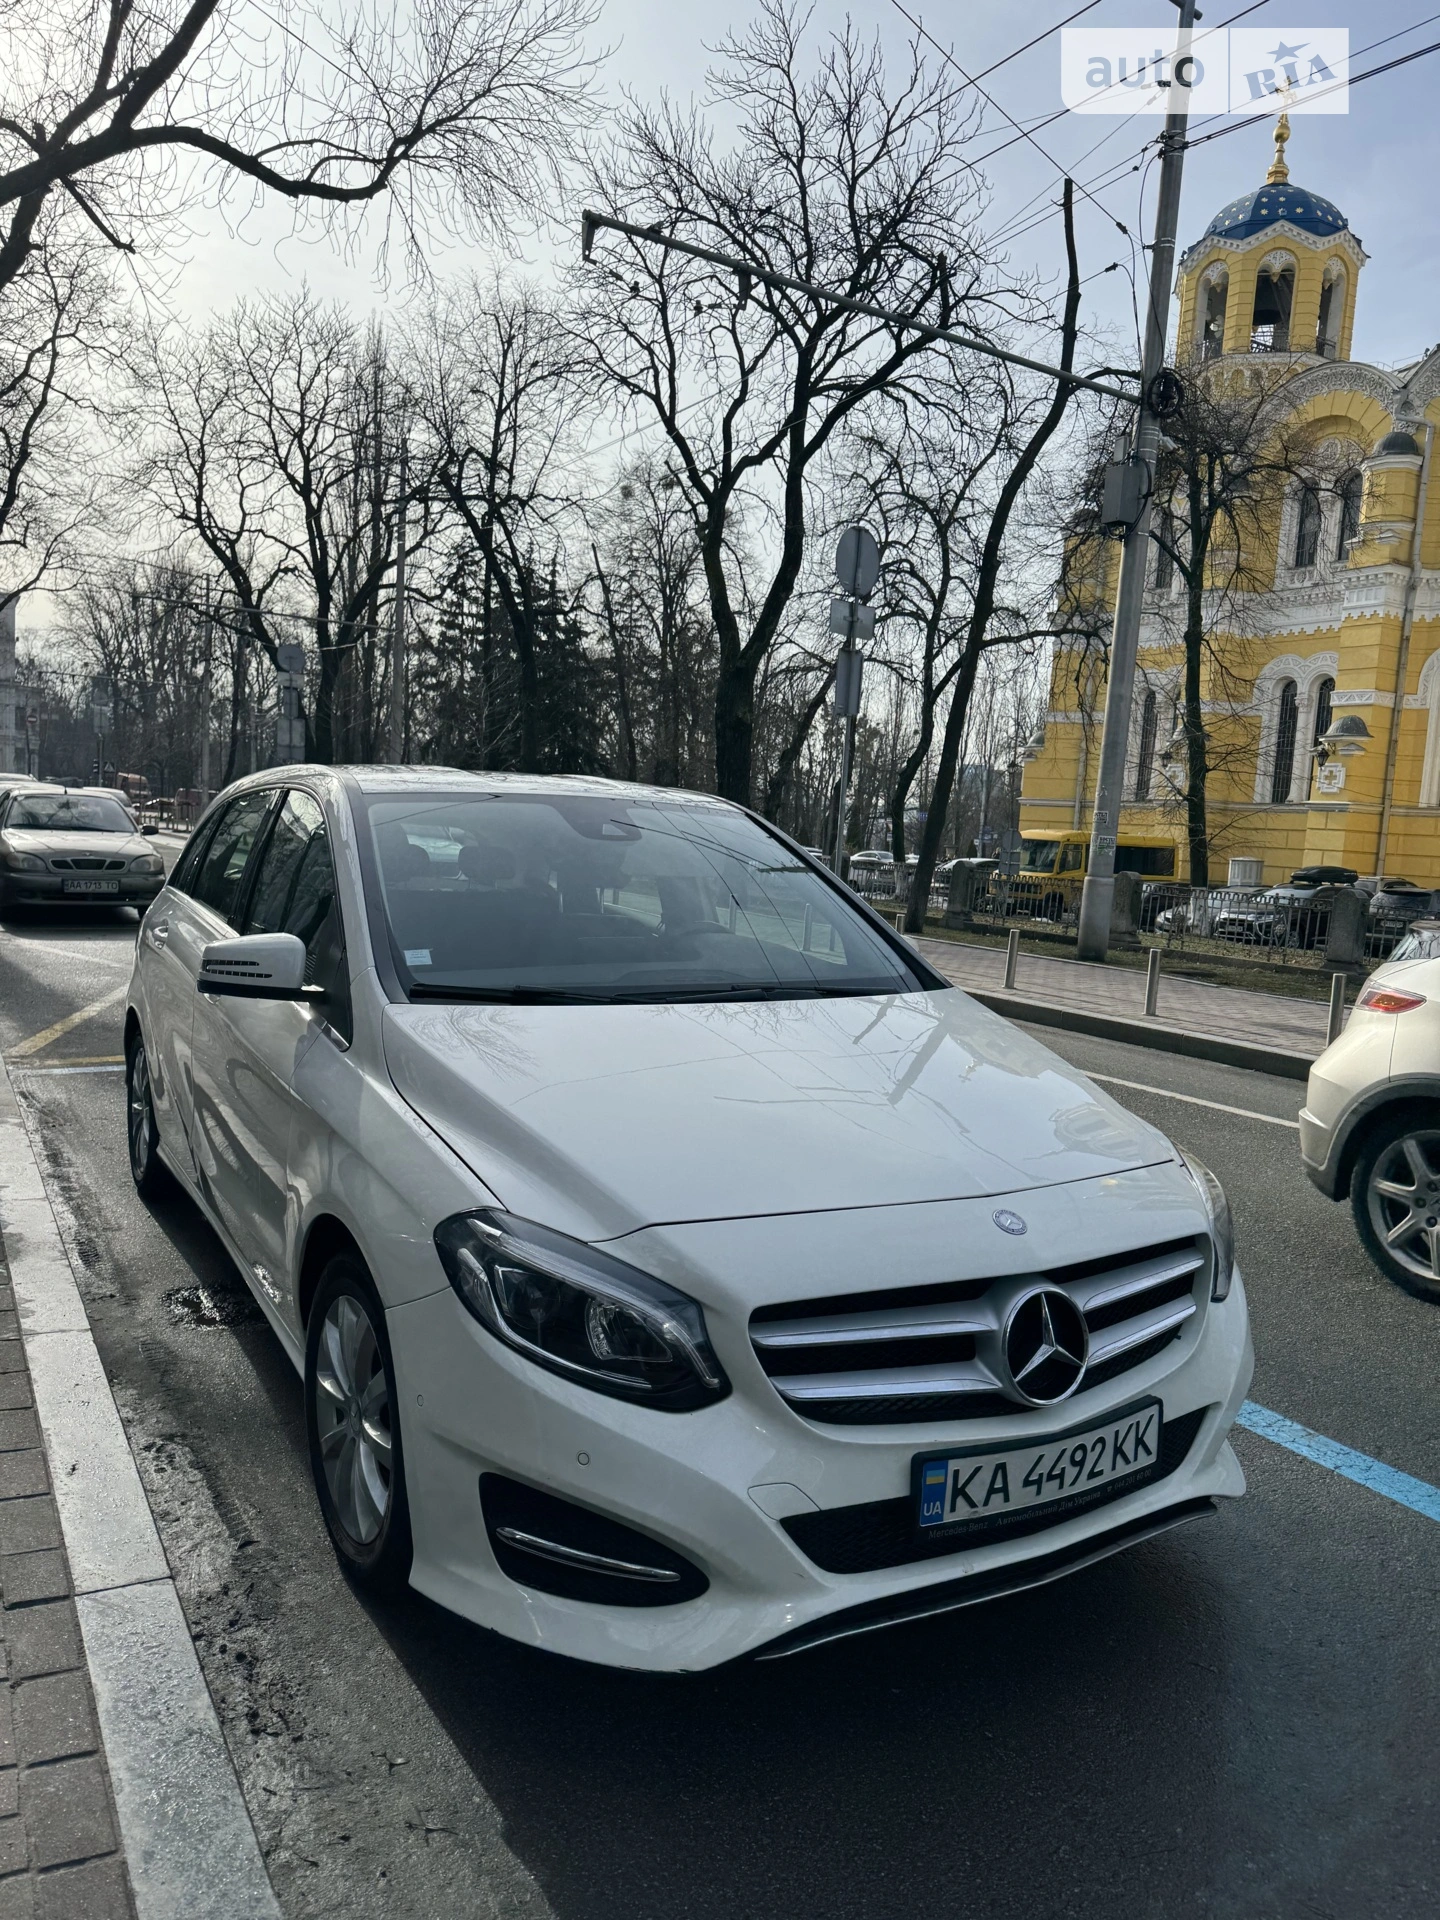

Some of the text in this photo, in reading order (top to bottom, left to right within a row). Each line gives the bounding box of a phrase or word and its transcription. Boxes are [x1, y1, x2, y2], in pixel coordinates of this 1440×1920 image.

[949, 1461, 1010, 1513] KA
[923, 1502, 942, 1517] UA
[928, 1521, 988, 1540] Mercedes-Benz
